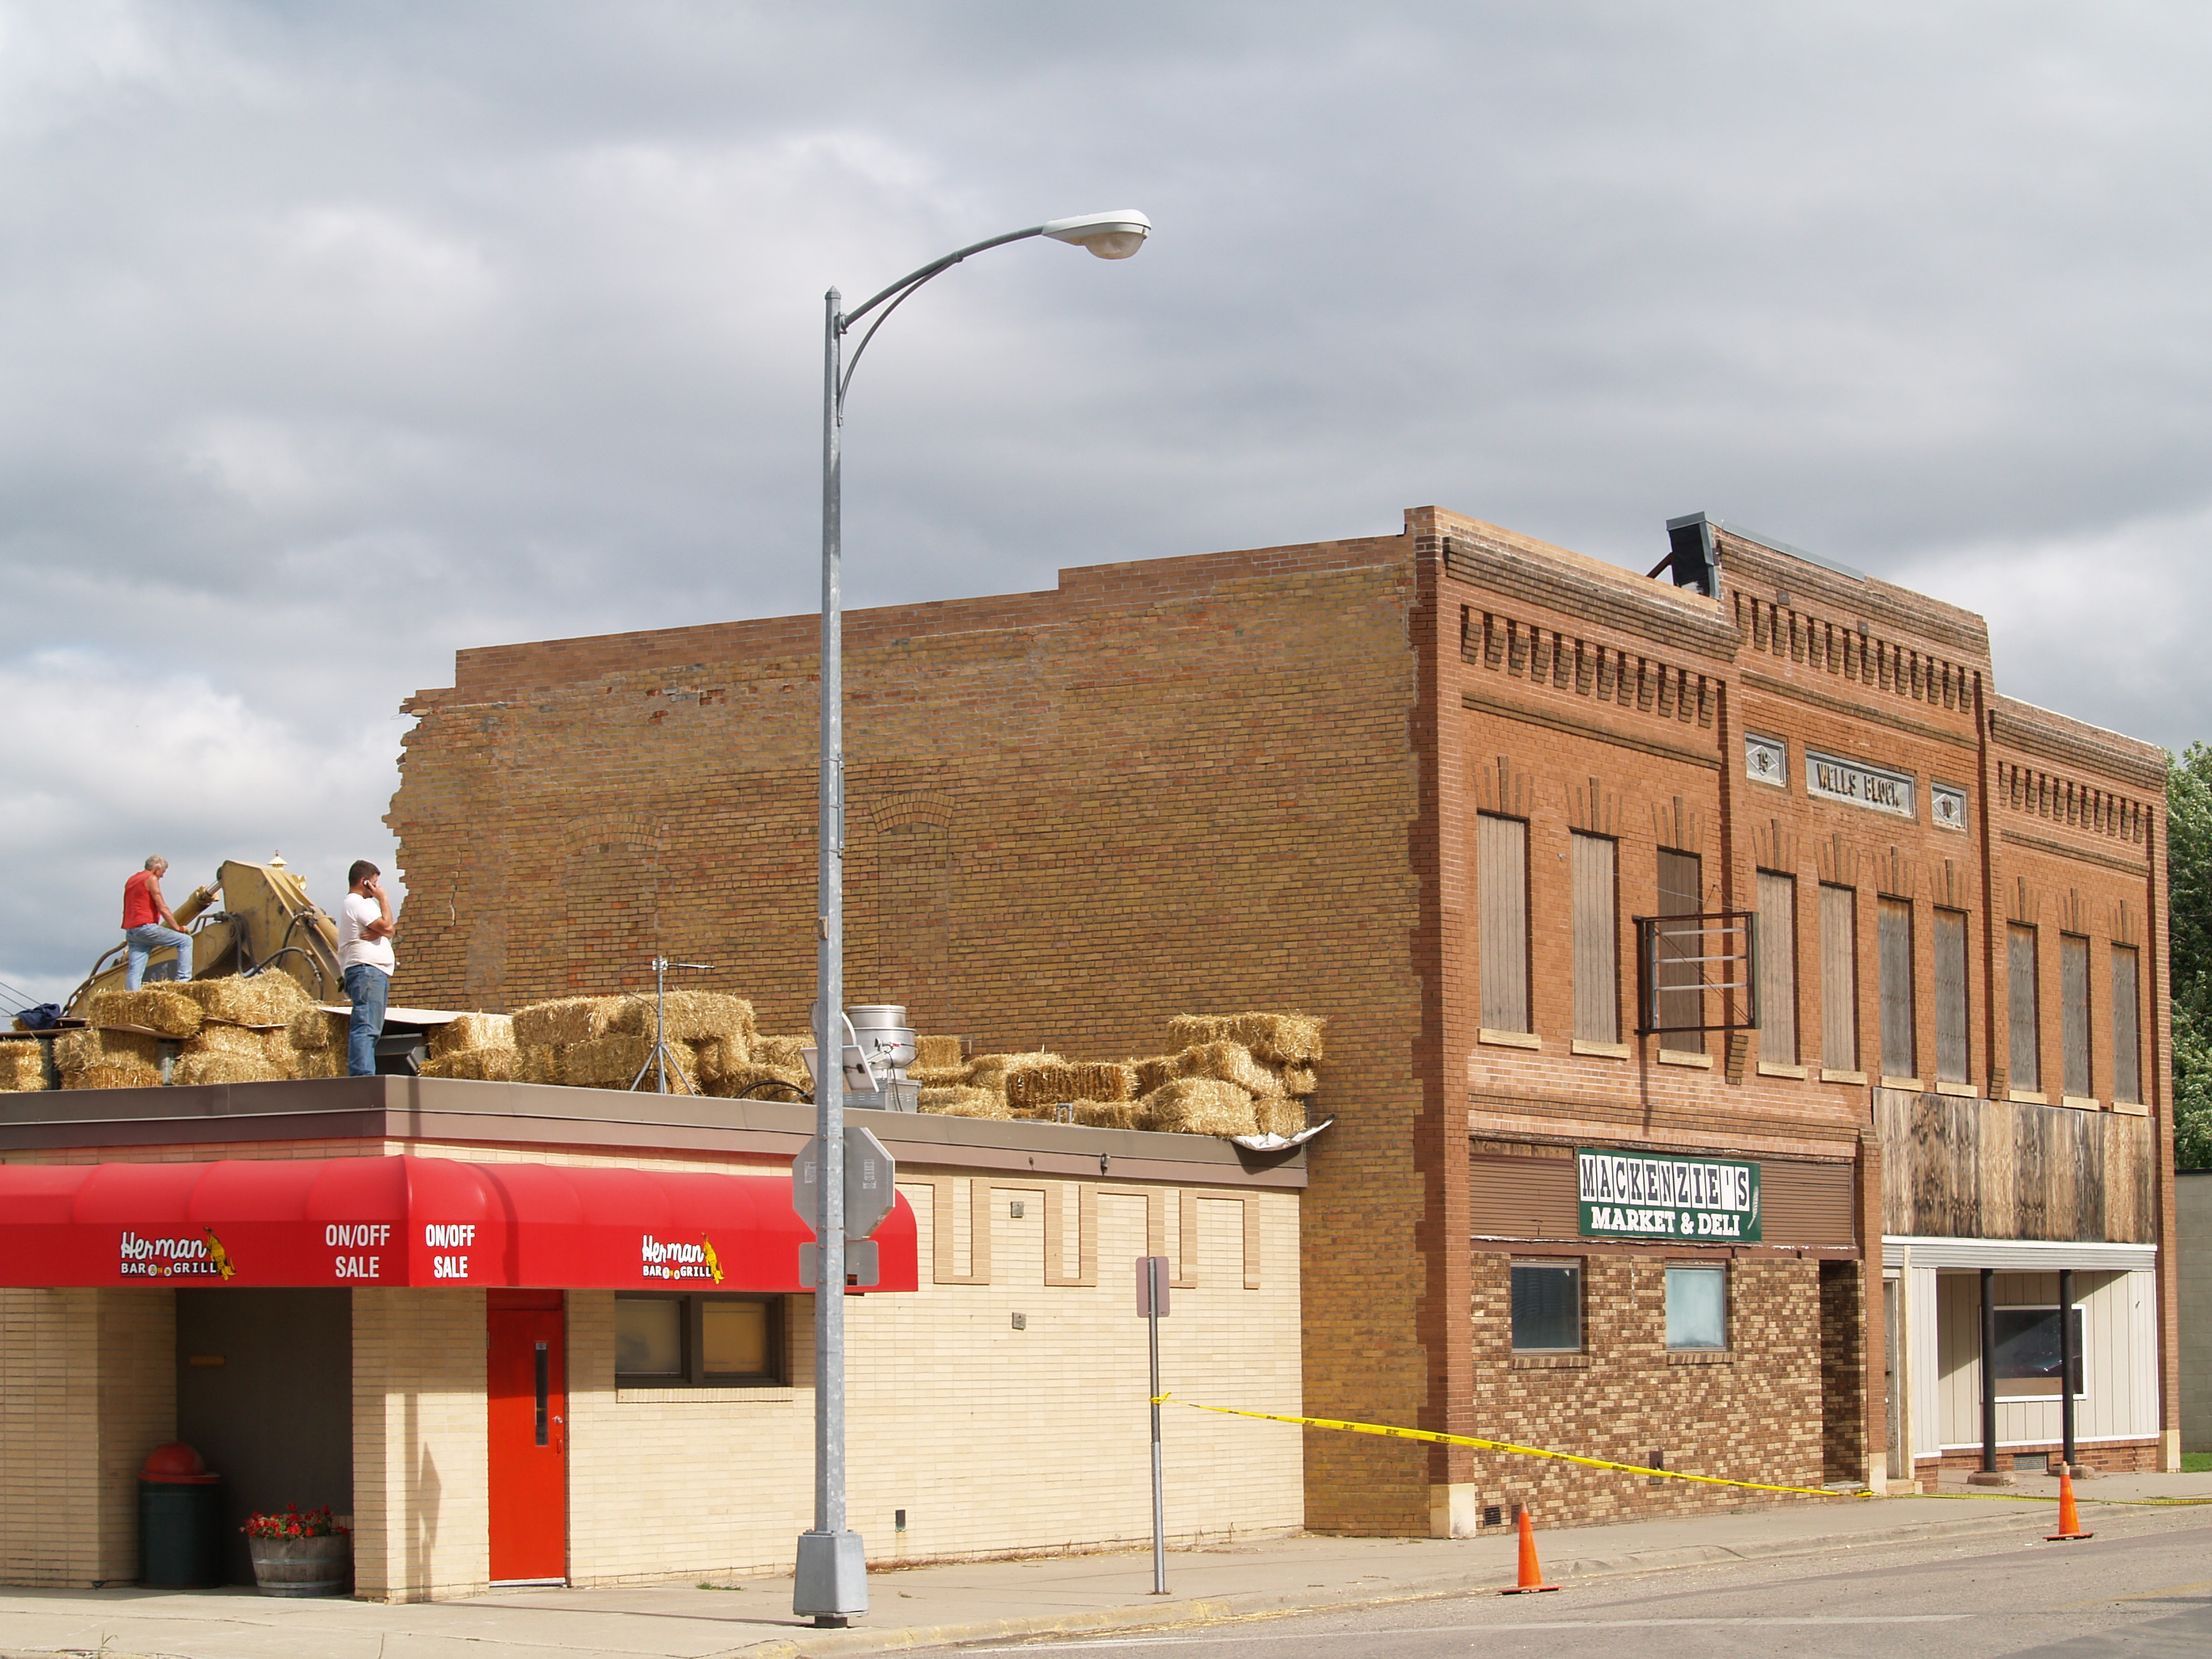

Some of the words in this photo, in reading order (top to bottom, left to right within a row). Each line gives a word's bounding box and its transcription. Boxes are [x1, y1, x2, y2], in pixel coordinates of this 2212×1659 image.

[1816, 762, 1857, 796] WELLS
[1864, 775, 1900, 808] BLOCK
[1581, 1158, 1748, 1207] MACKENZIE'S
[1591, 1206, 1676, 1233] MARKET
[1680, 1212, 1694, 1235] &
[1697, 1213, 1740, 1236] DELI
[121, 1231, 207, 1260] Herman
[325, 1224, 390, 1248] ON/OFF
[425, 1224, 476, 1248] ON/OFF
[642, 1234, 705, 1263] Herman
[121, 1262, 146, 1274] BAR
[173, 1262, 217, 1273] GRILL
[335, 1256, 380, 1278] SALE
[434, 1255, 469, 1278] SALE
[642, 1265, 662, 1276] BAR
[680, 1265, 712, 1277] GRILL
